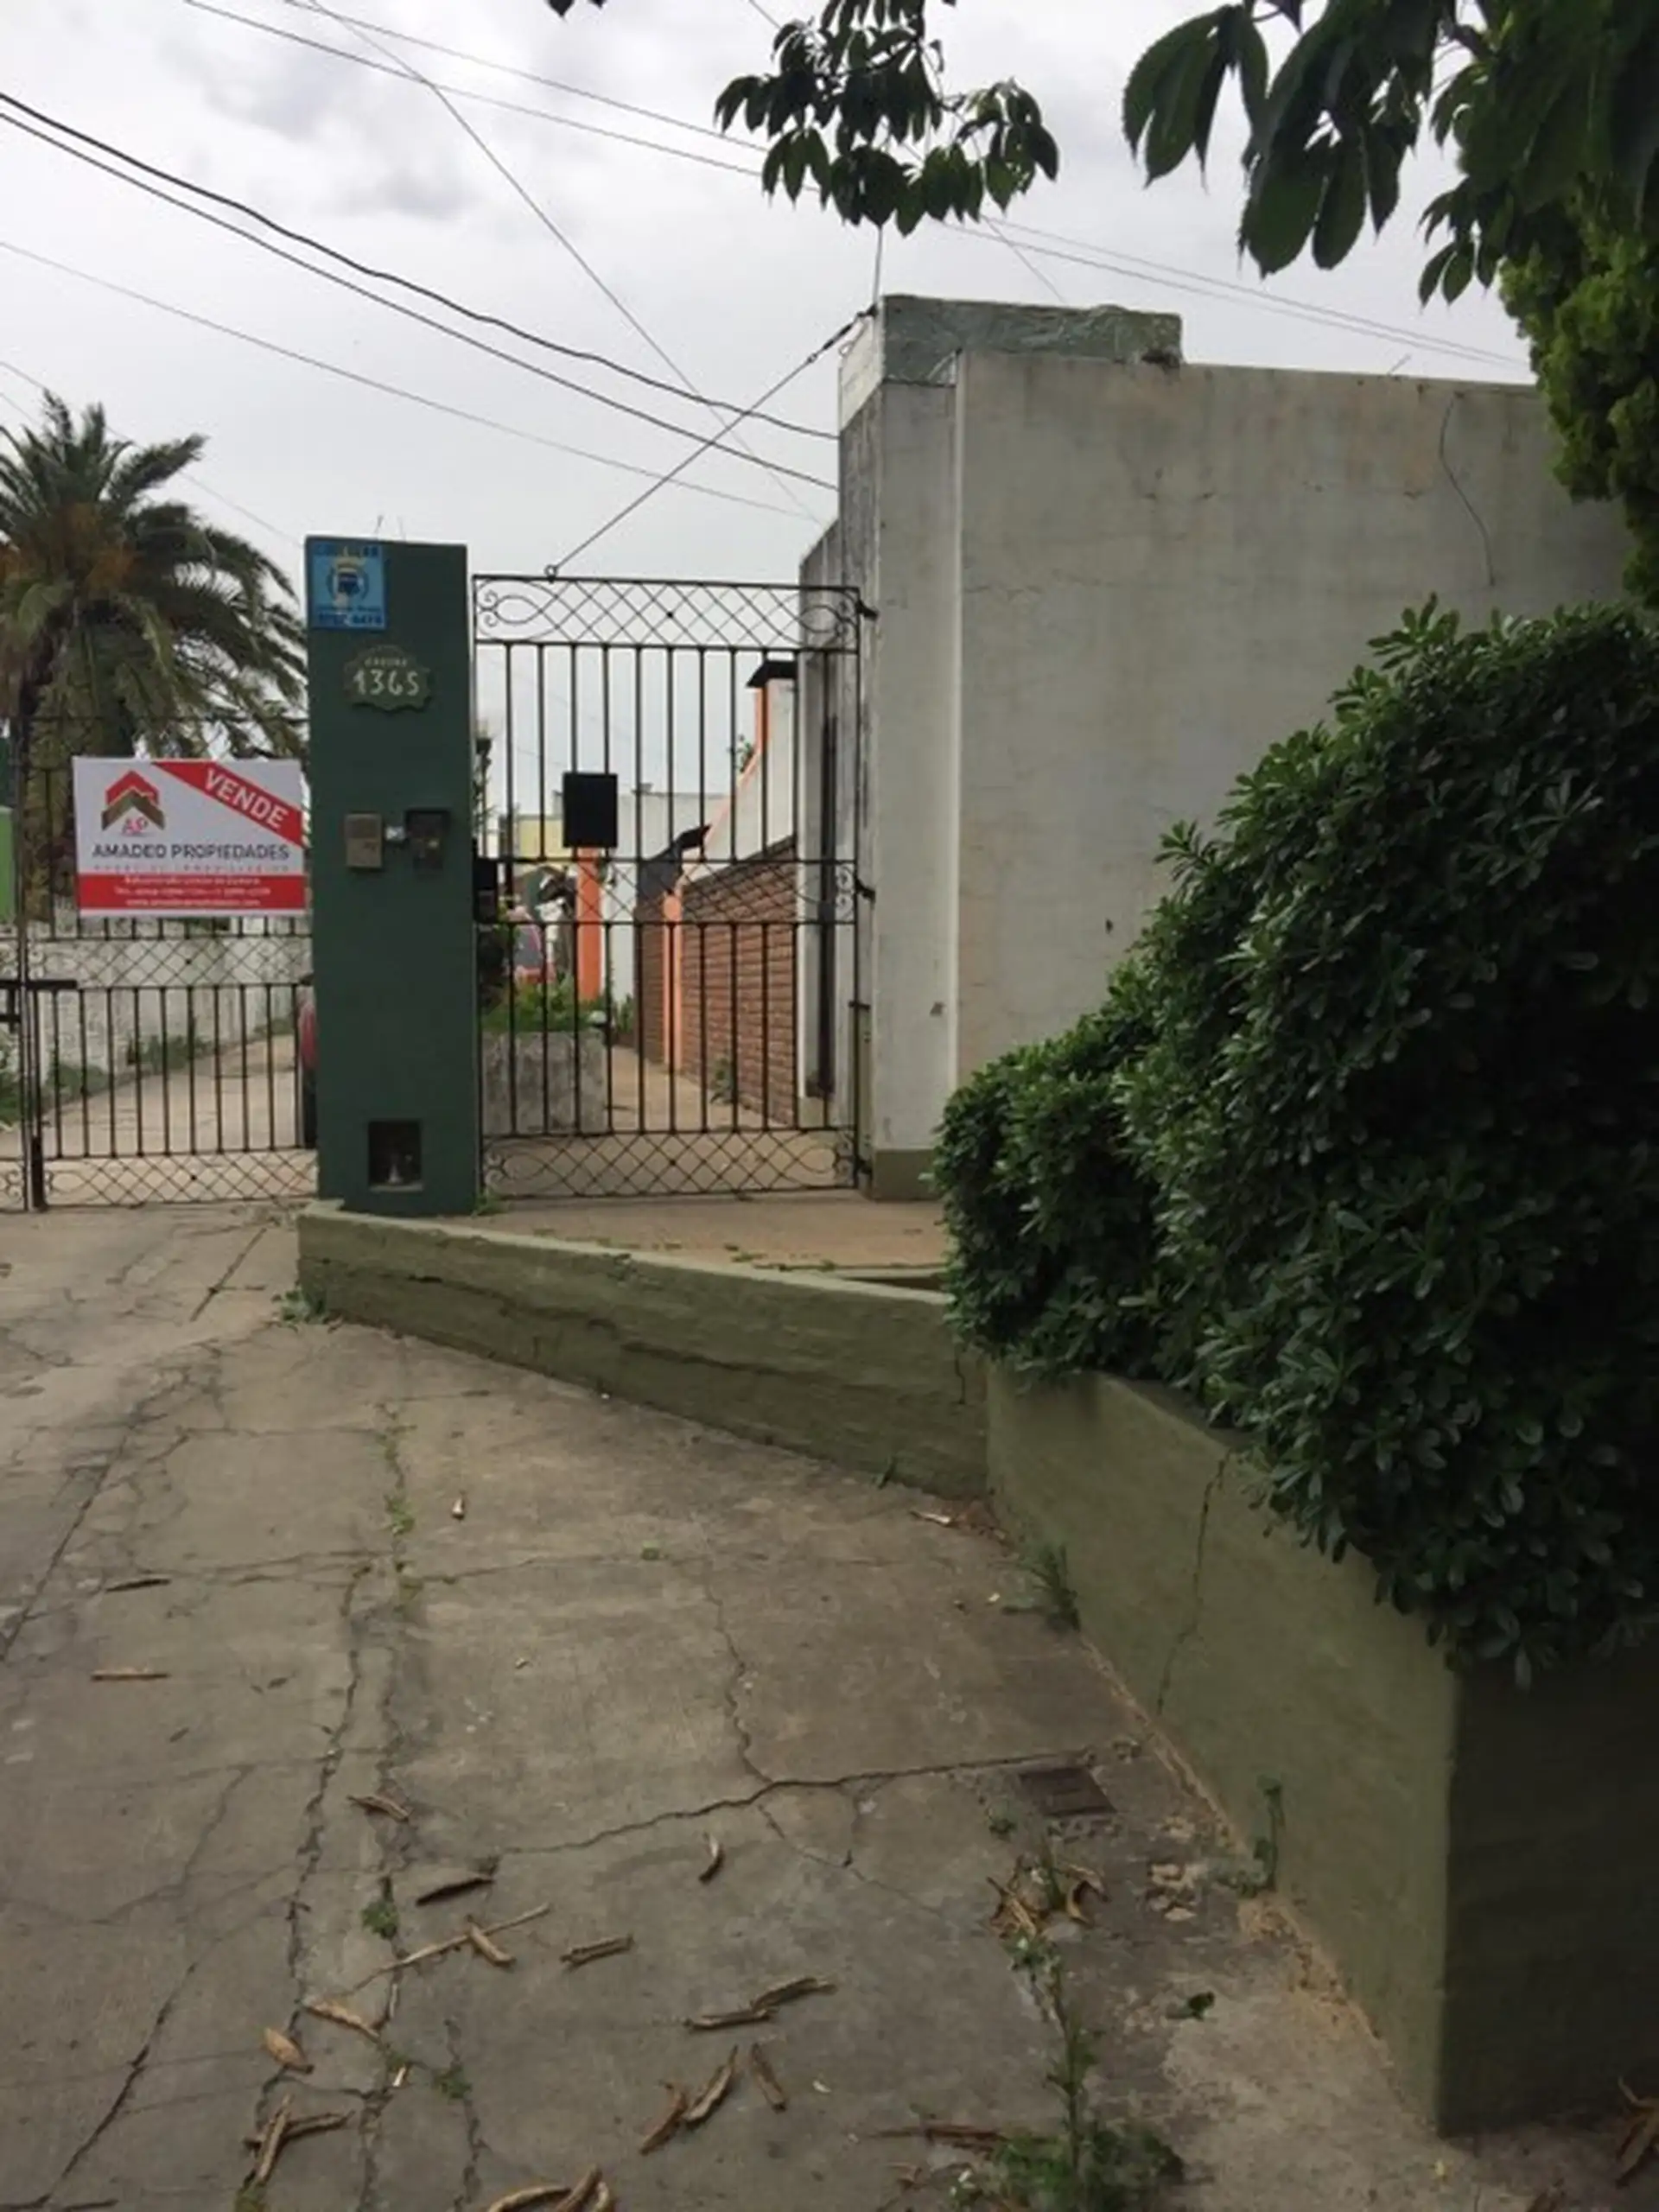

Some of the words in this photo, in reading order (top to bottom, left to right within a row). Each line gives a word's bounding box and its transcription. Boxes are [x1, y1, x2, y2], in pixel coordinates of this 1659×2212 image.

[353, 668, 421, 696] 1365
[204, 768, 289, 830] VENDE
[92, 843, 167, 859] AMADEO
[170, 843, 290, 861] PROPIEDADES
